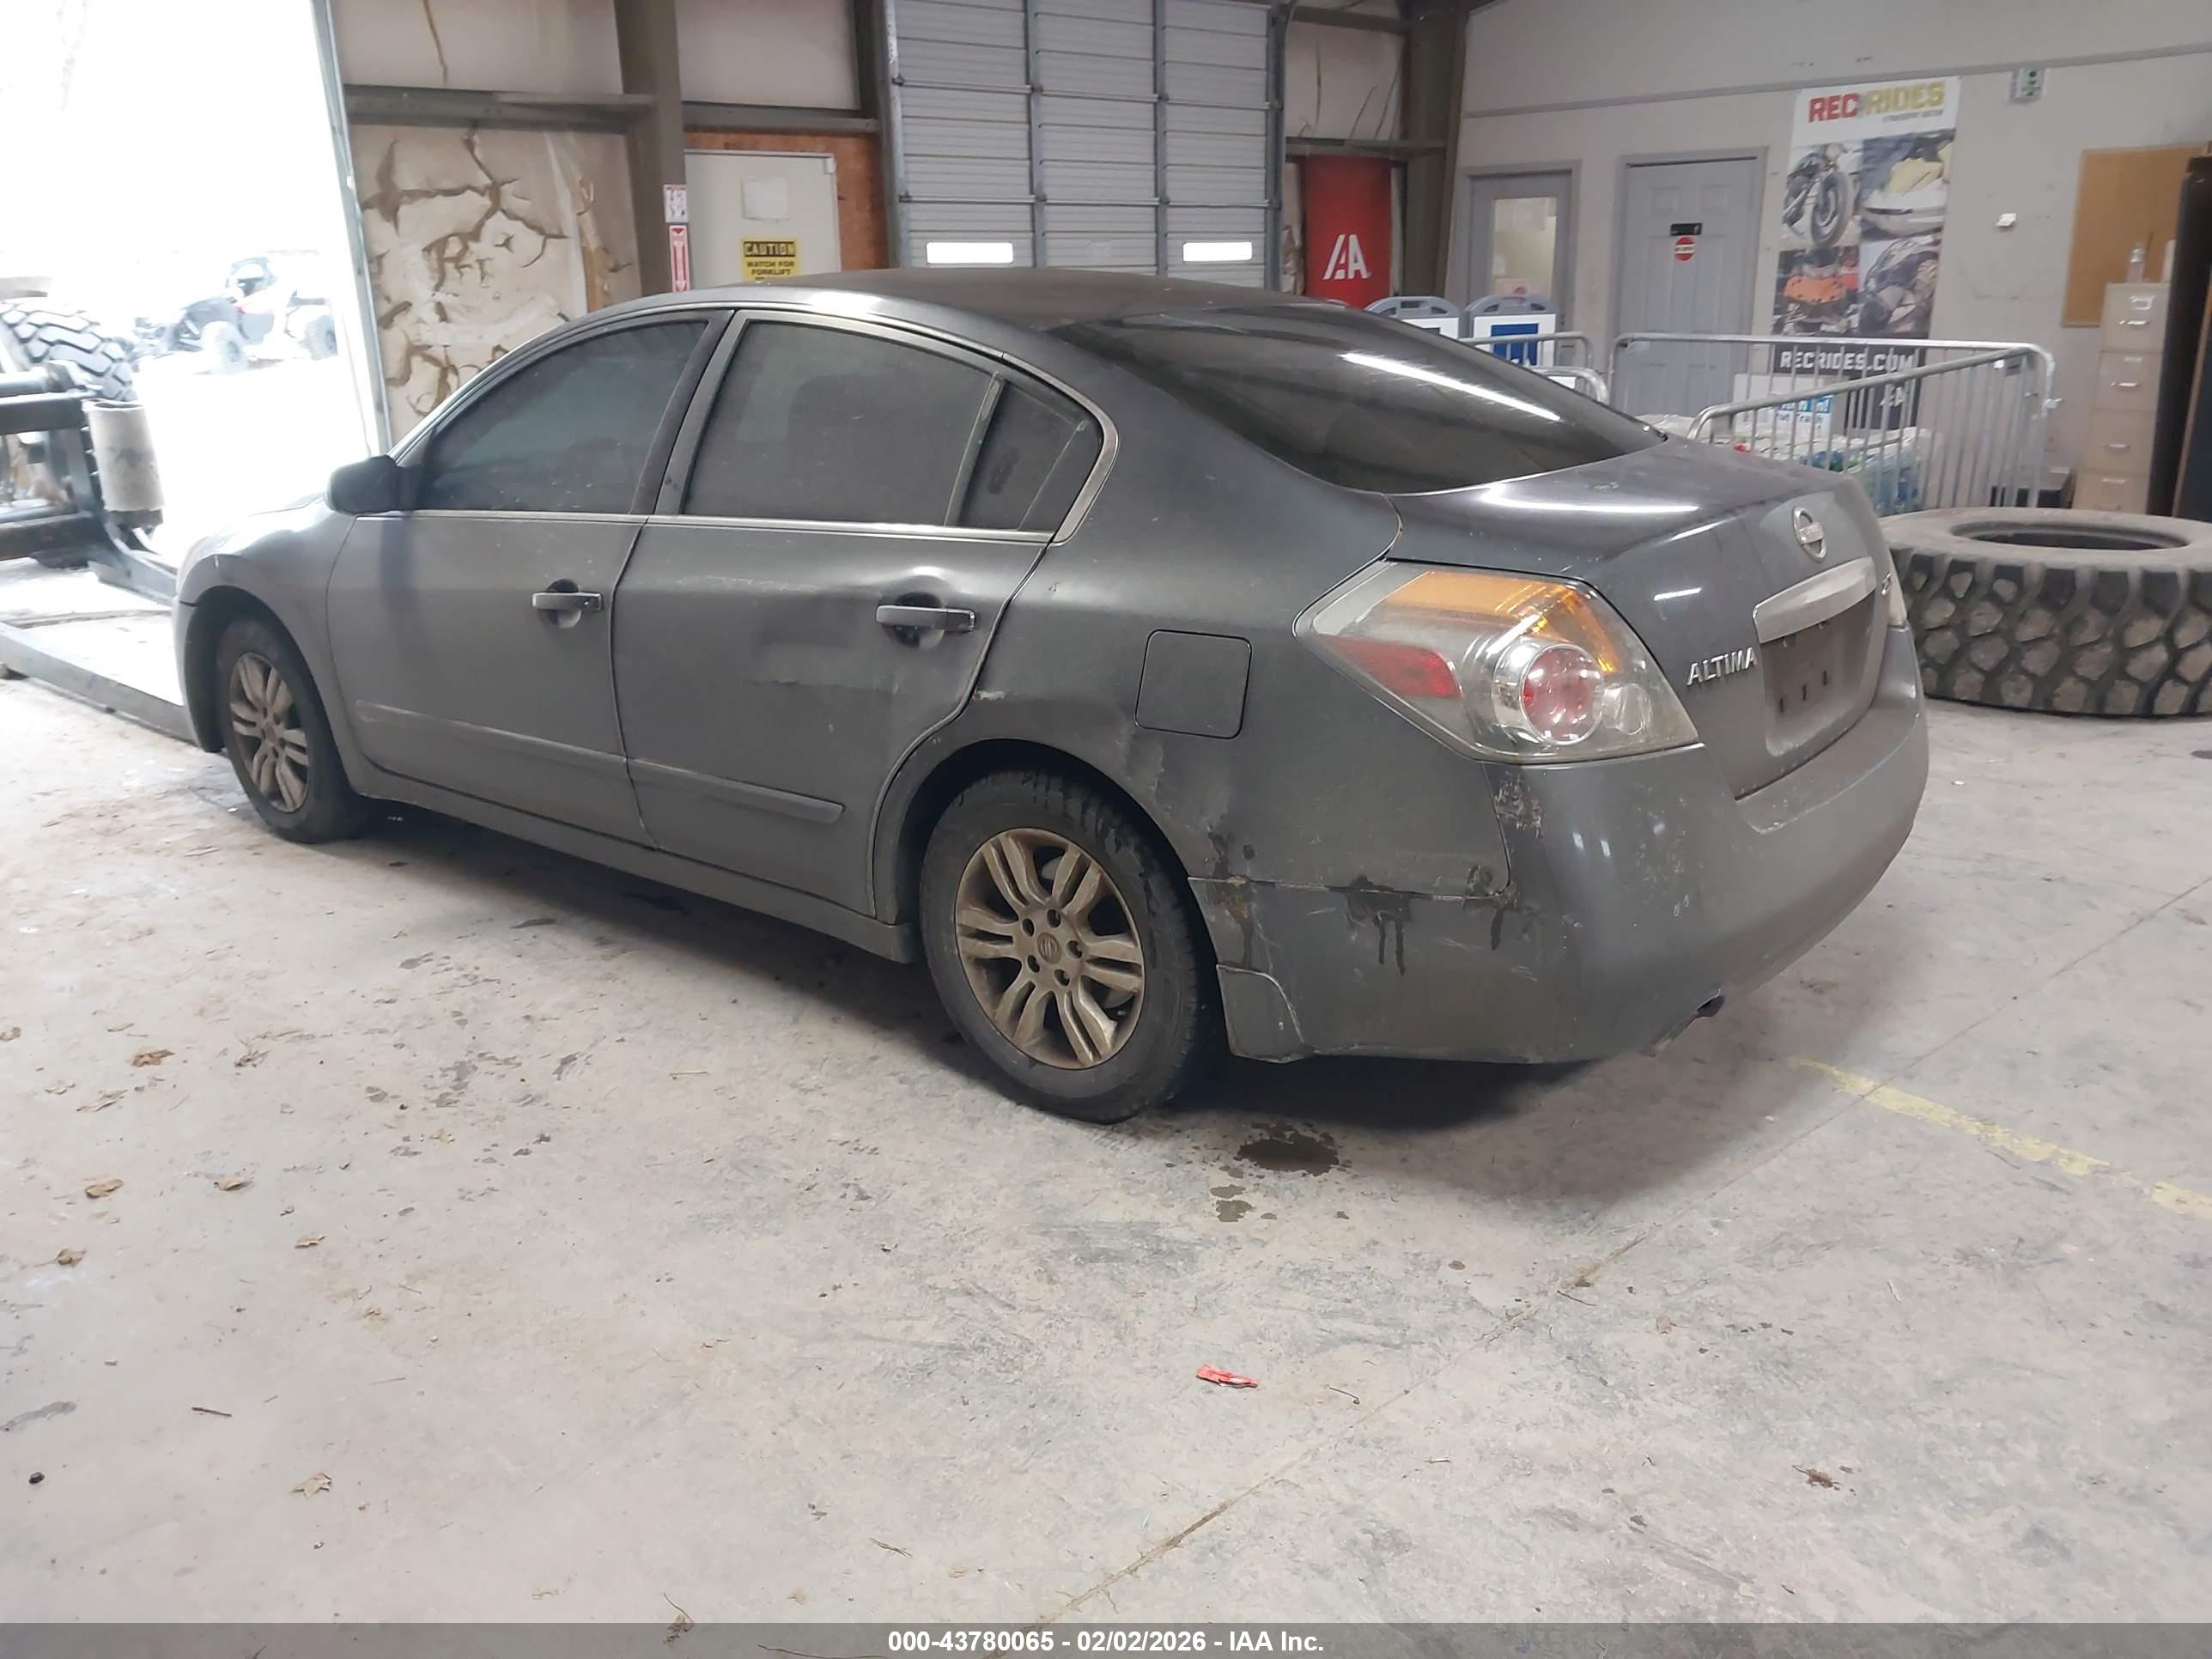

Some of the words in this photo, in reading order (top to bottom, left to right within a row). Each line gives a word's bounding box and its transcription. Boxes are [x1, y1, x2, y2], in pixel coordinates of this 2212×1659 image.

[1808, 92, 1862, 123] REC
[1865, 82, 1946, 115] RIDES
[744, 242, 797, 256] CAUTION
[1686, 647, 1759, 686] ALTIMA
